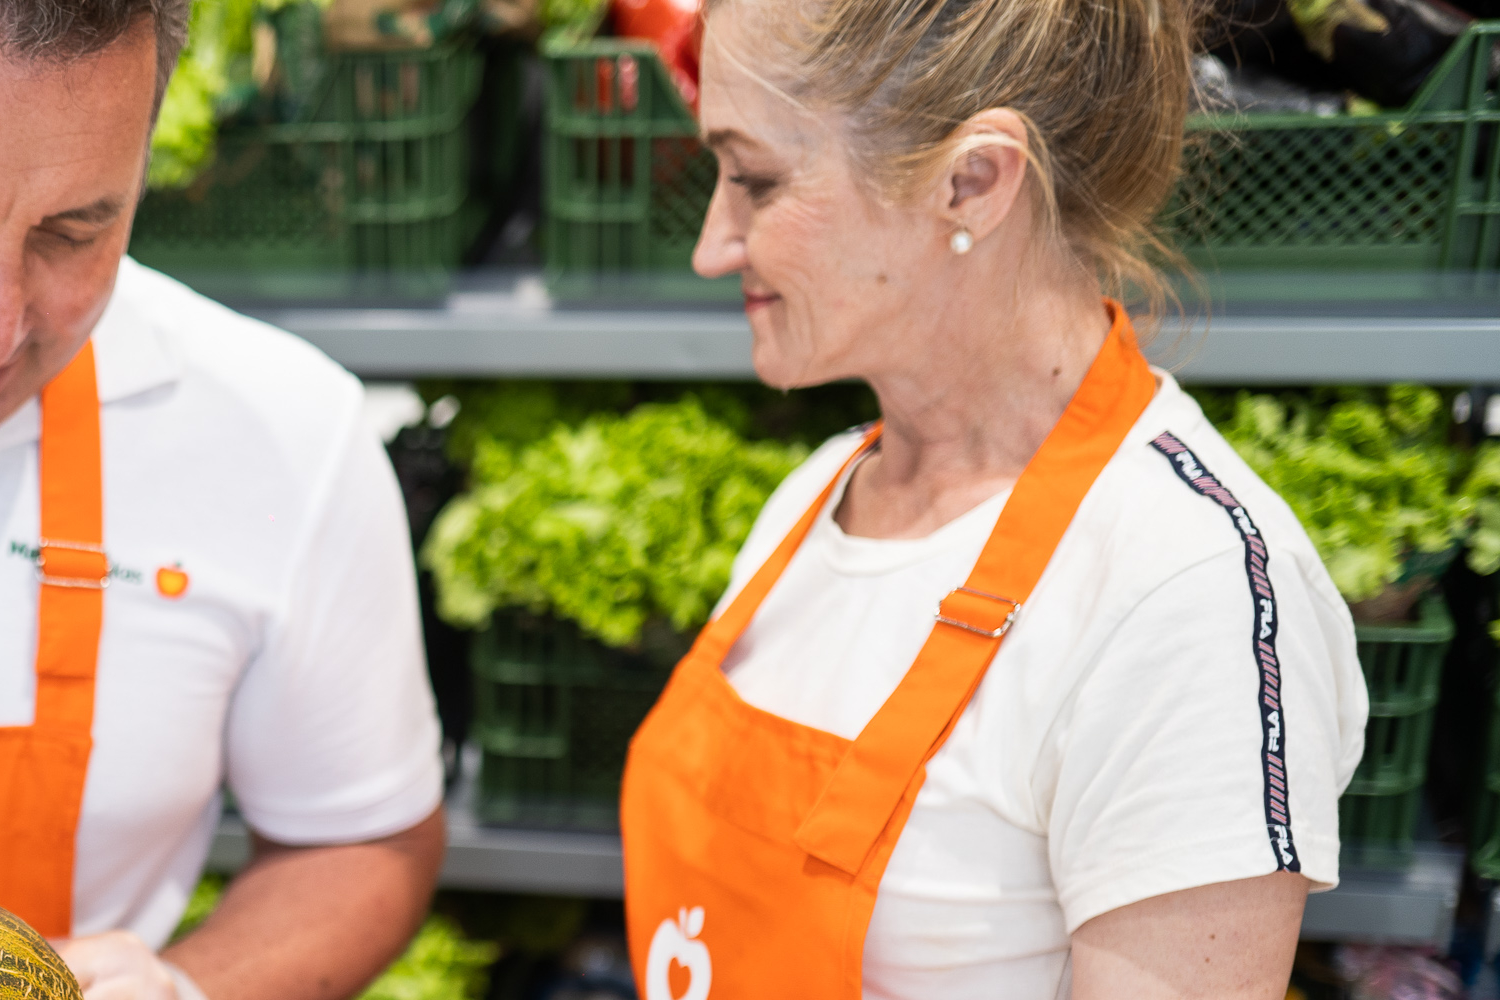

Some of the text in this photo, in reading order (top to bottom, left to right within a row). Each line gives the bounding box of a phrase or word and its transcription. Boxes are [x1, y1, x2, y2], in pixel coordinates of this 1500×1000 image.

[1259, 599, 1273, 639] FILA
[1267, 710, 1280, 752] FILA
[1273, 825, 1293, 867] FILA
